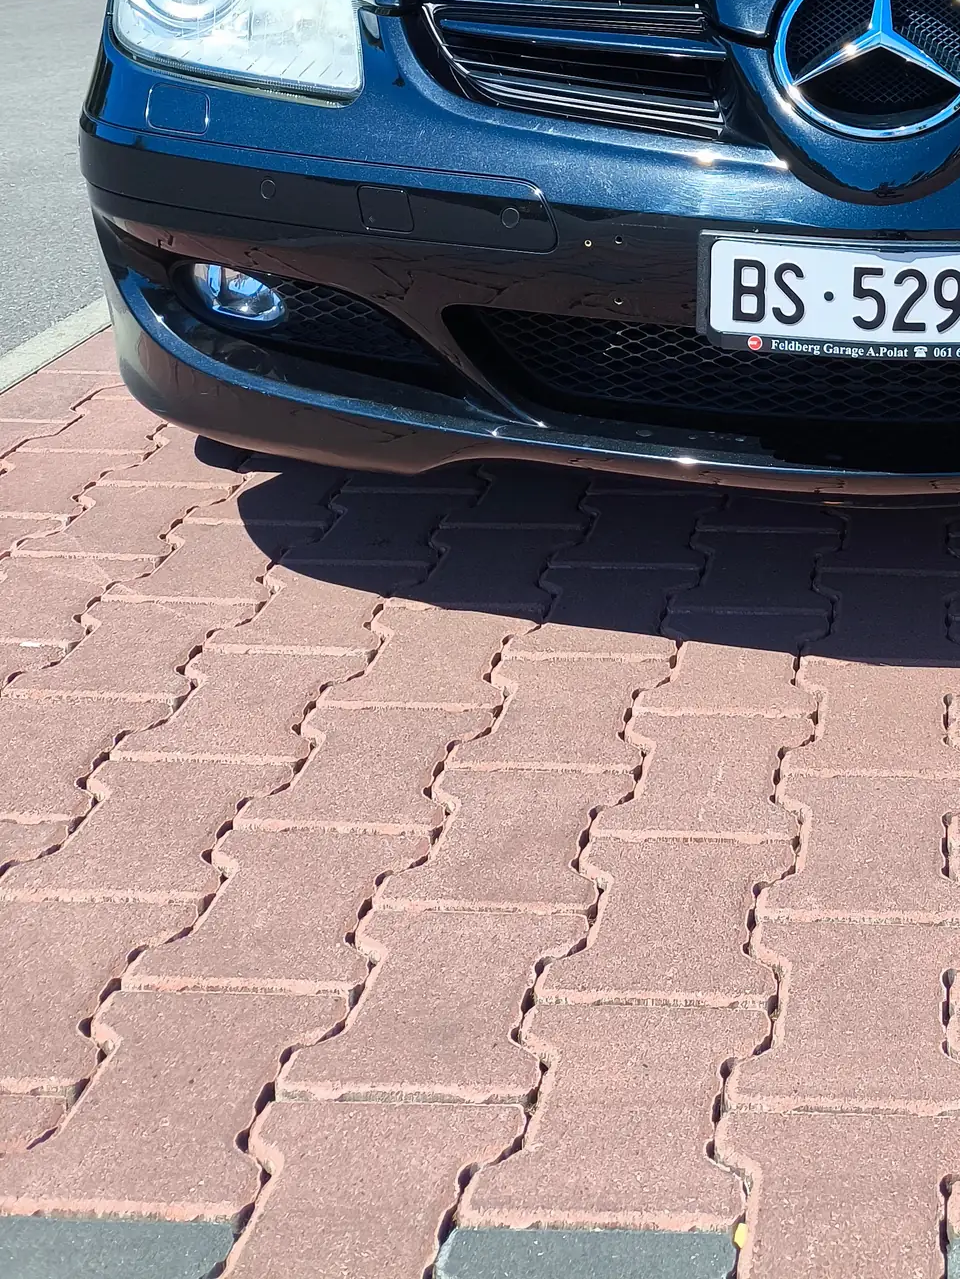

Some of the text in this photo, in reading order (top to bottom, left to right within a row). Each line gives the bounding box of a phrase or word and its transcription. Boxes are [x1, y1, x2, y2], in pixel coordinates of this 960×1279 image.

[770, 339, 821, 355] Feldberg
[823, 343, 865, 358] Garage
[933, 347, 952, 358] 061
